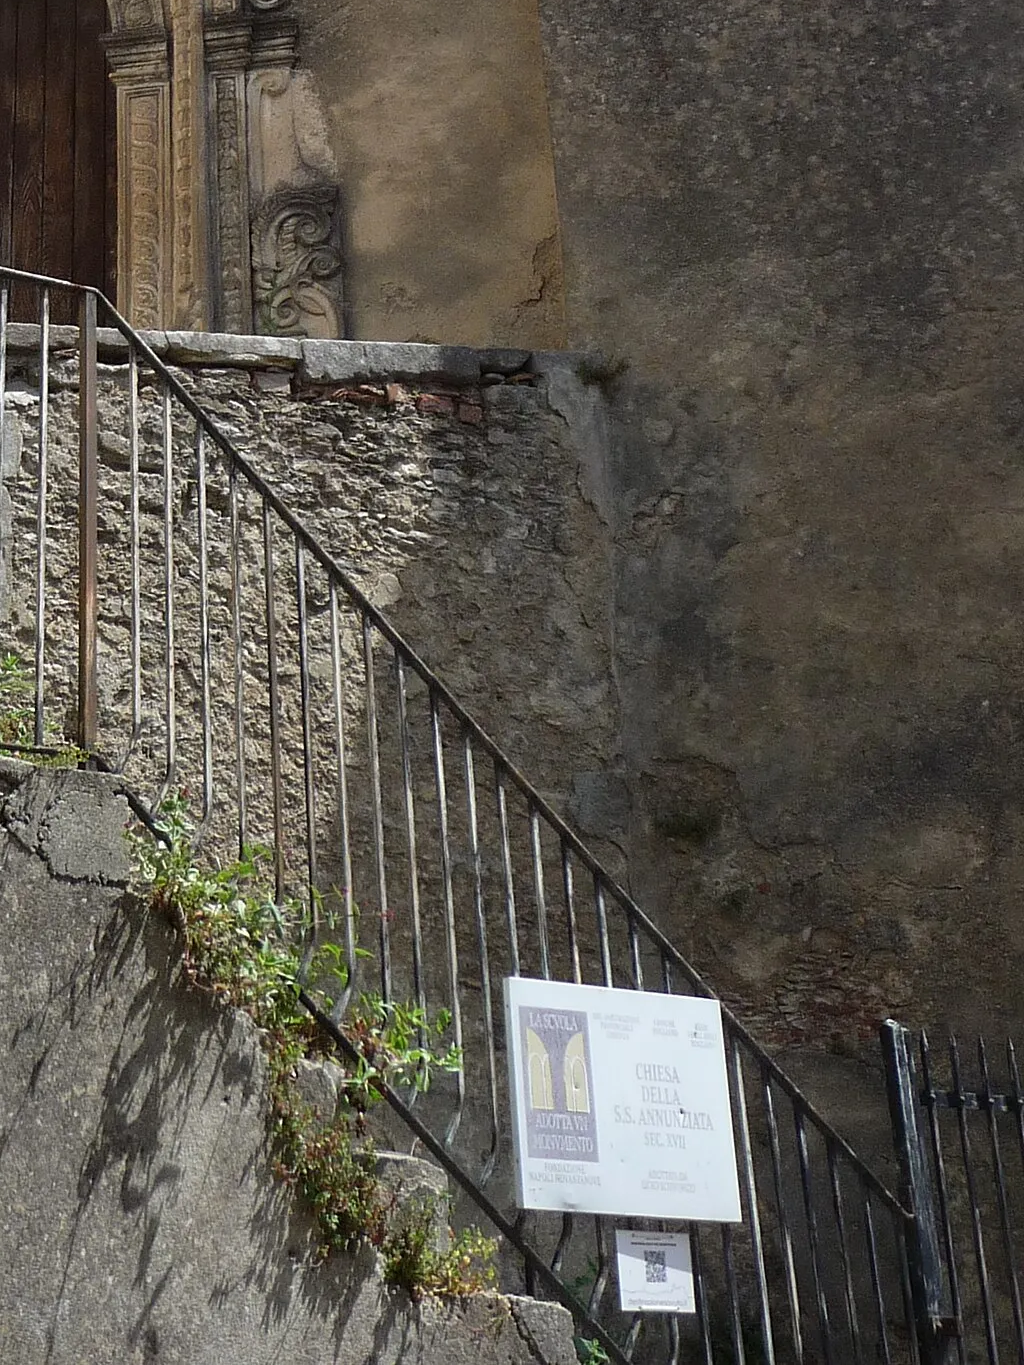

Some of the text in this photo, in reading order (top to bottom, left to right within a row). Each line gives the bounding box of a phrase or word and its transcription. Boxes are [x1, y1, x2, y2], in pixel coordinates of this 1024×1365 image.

[529, 1011, 543, 1028] LA
[635, 1062, 680, 1084] CHIESA
[641, 1085, 681, 1105] DELLA
[536, 1113, 574, 1131] ADOTTA
[614, 1105, 715, 1131] S.S. ANNUNZIATA
[644, 1131, 687, 1150] SEC. XVII
